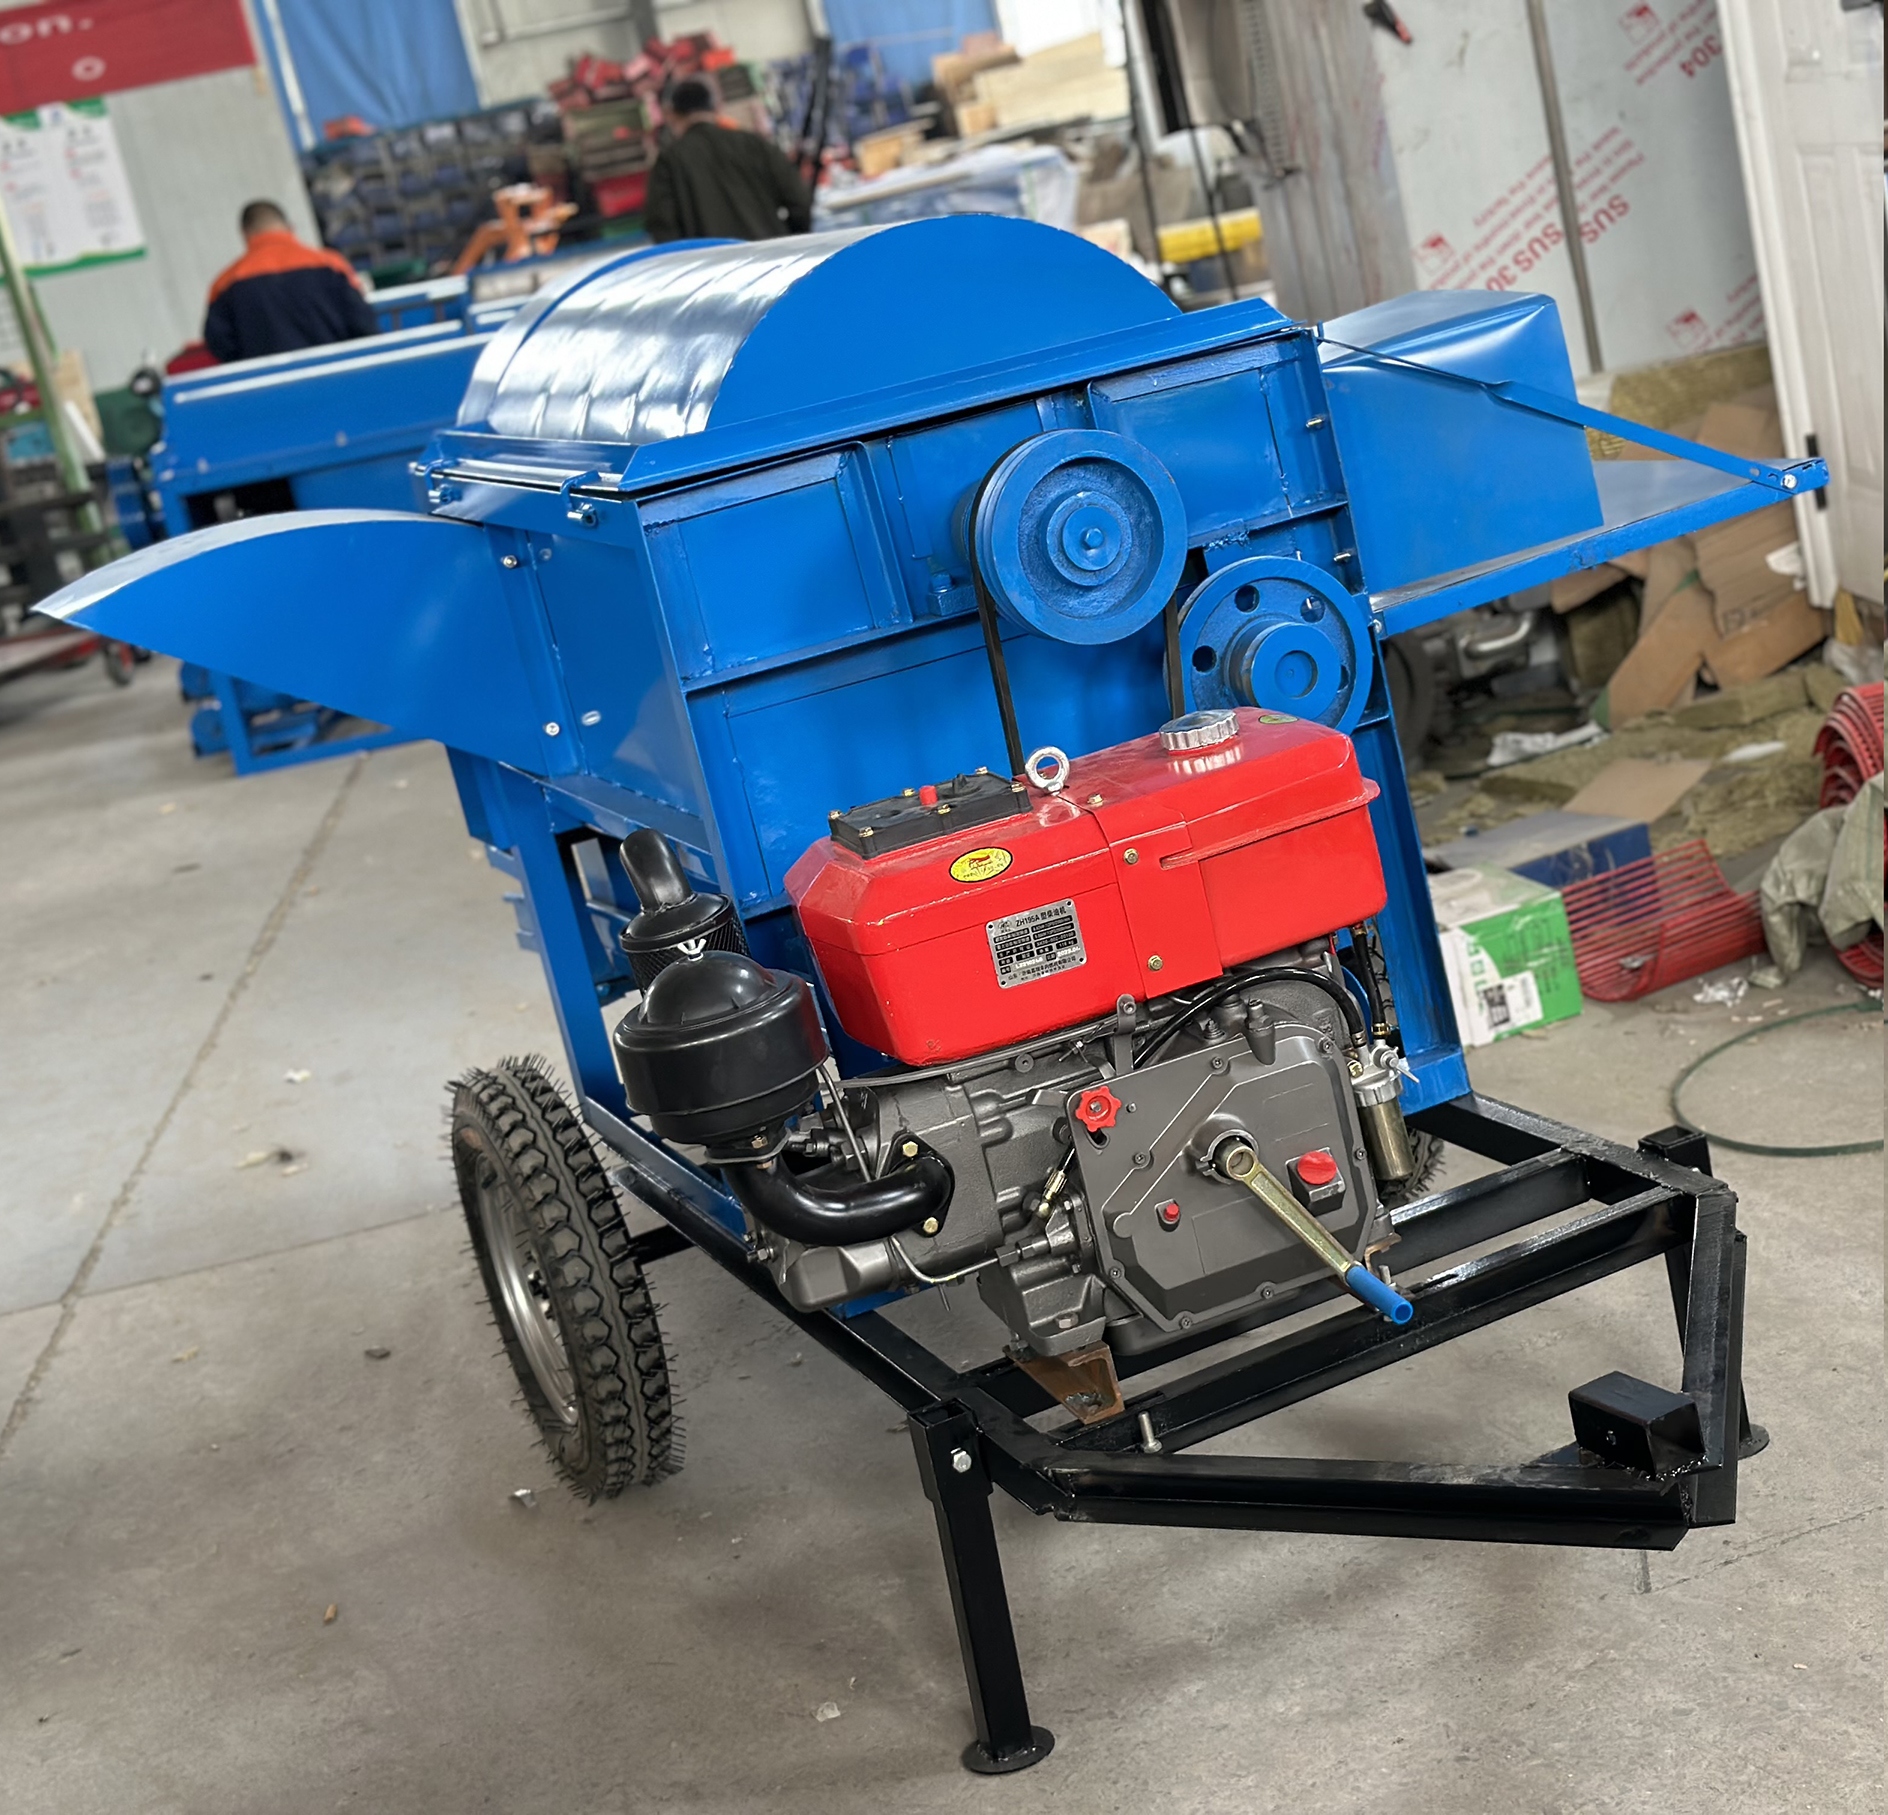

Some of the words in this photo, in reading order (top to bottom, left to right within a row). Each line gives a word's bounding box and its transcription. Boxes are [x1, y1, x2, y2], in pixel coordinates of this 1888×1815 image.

[1679, 34, 1724, 78] 304
[1578, 193, 1631, 244] SUS
[1511, 222, 1564, 274] SUS
[1484, 264, 1519, 292] 30
